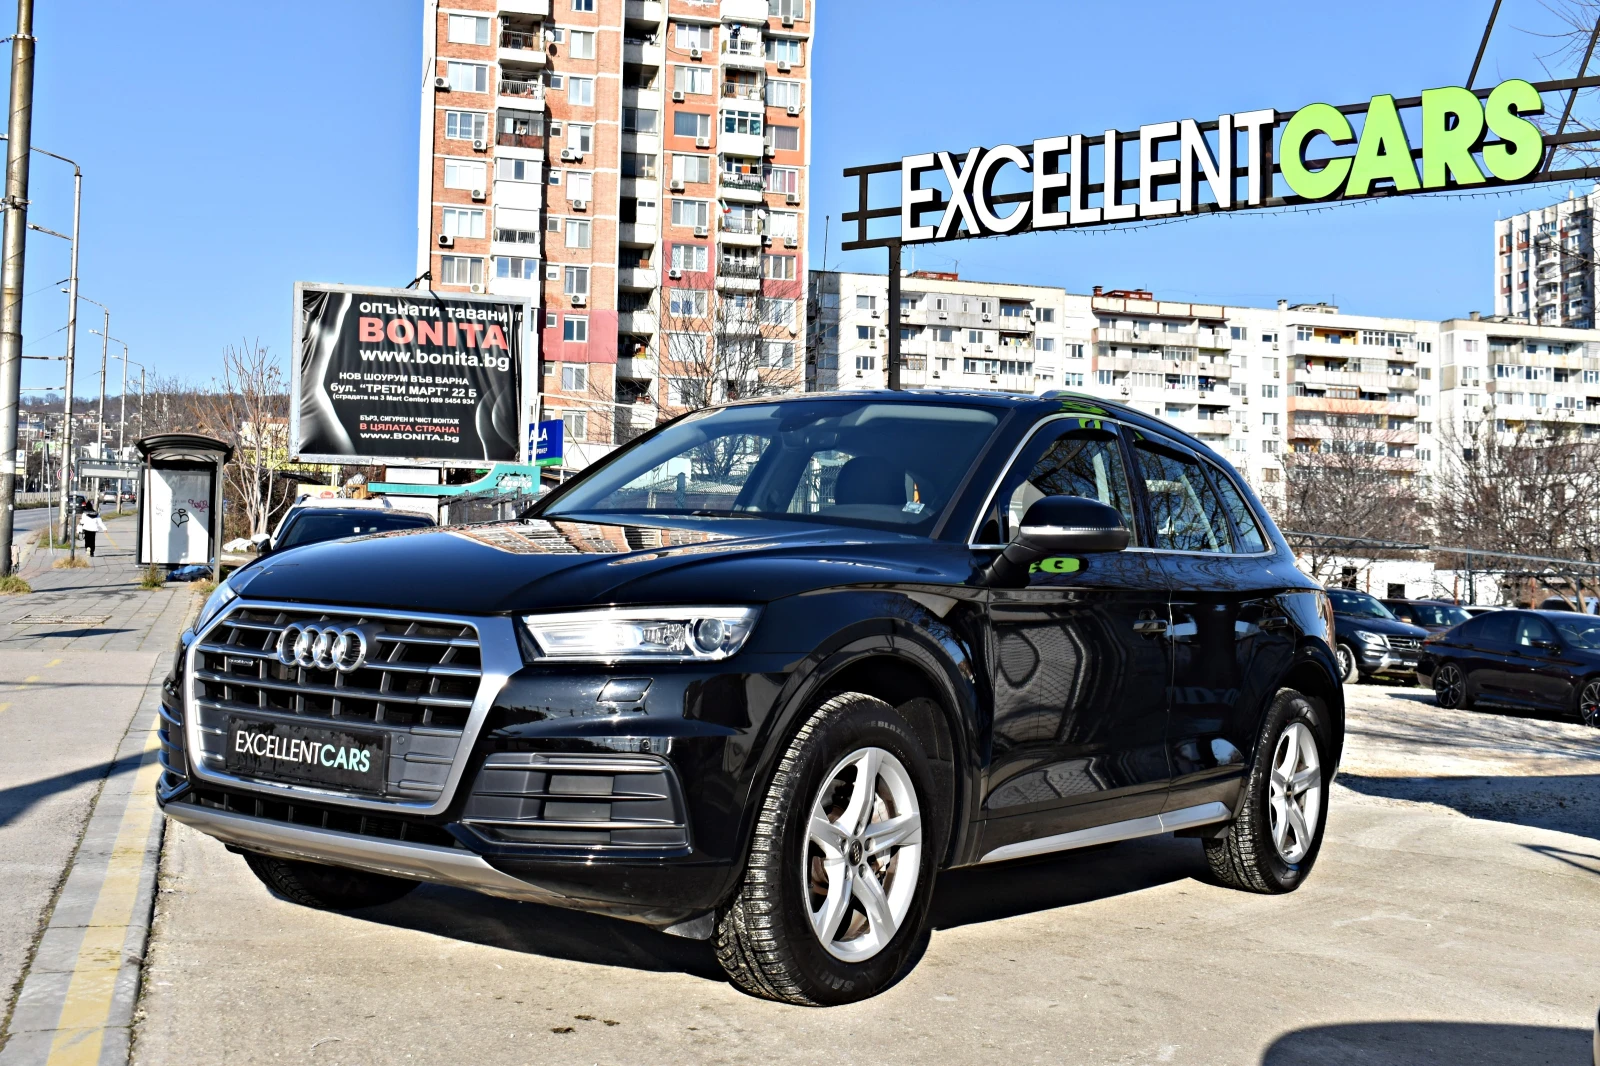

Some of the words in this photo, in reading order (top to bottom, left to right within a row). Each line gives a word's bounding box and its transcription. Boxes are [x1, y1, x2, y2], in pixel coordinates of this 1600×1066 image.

[359, 302, 440, 317] опънати
[445, 307, 508, 322] тавани
[359, 316, 508, 350] BONITA
[359, 349, 510, 371] www.bonita.bg
[339, 372, 361, 380] НОВ
[364, 373, 408, 382] ШОУРУМ
[411, 375, 433, 384] ВЪВ
[435, 376, 469, 385] ВАРНА
[330, 383, 356, 393] бул.
[452, 388, 465, 397] 22
[468, 389, 477, 397] Б
[333, 393, 368, 401] (сградата
[380, 415, 408, 423] СИГУРЕН
[370, 423, 412, 432] ЦЯЛАТА
[415, 424, 459, 433] СТРАНА!
[359, 432, 460, 443] www.BONITA.bg
[235, 730, 371, 772] EXCELLENTCARS
